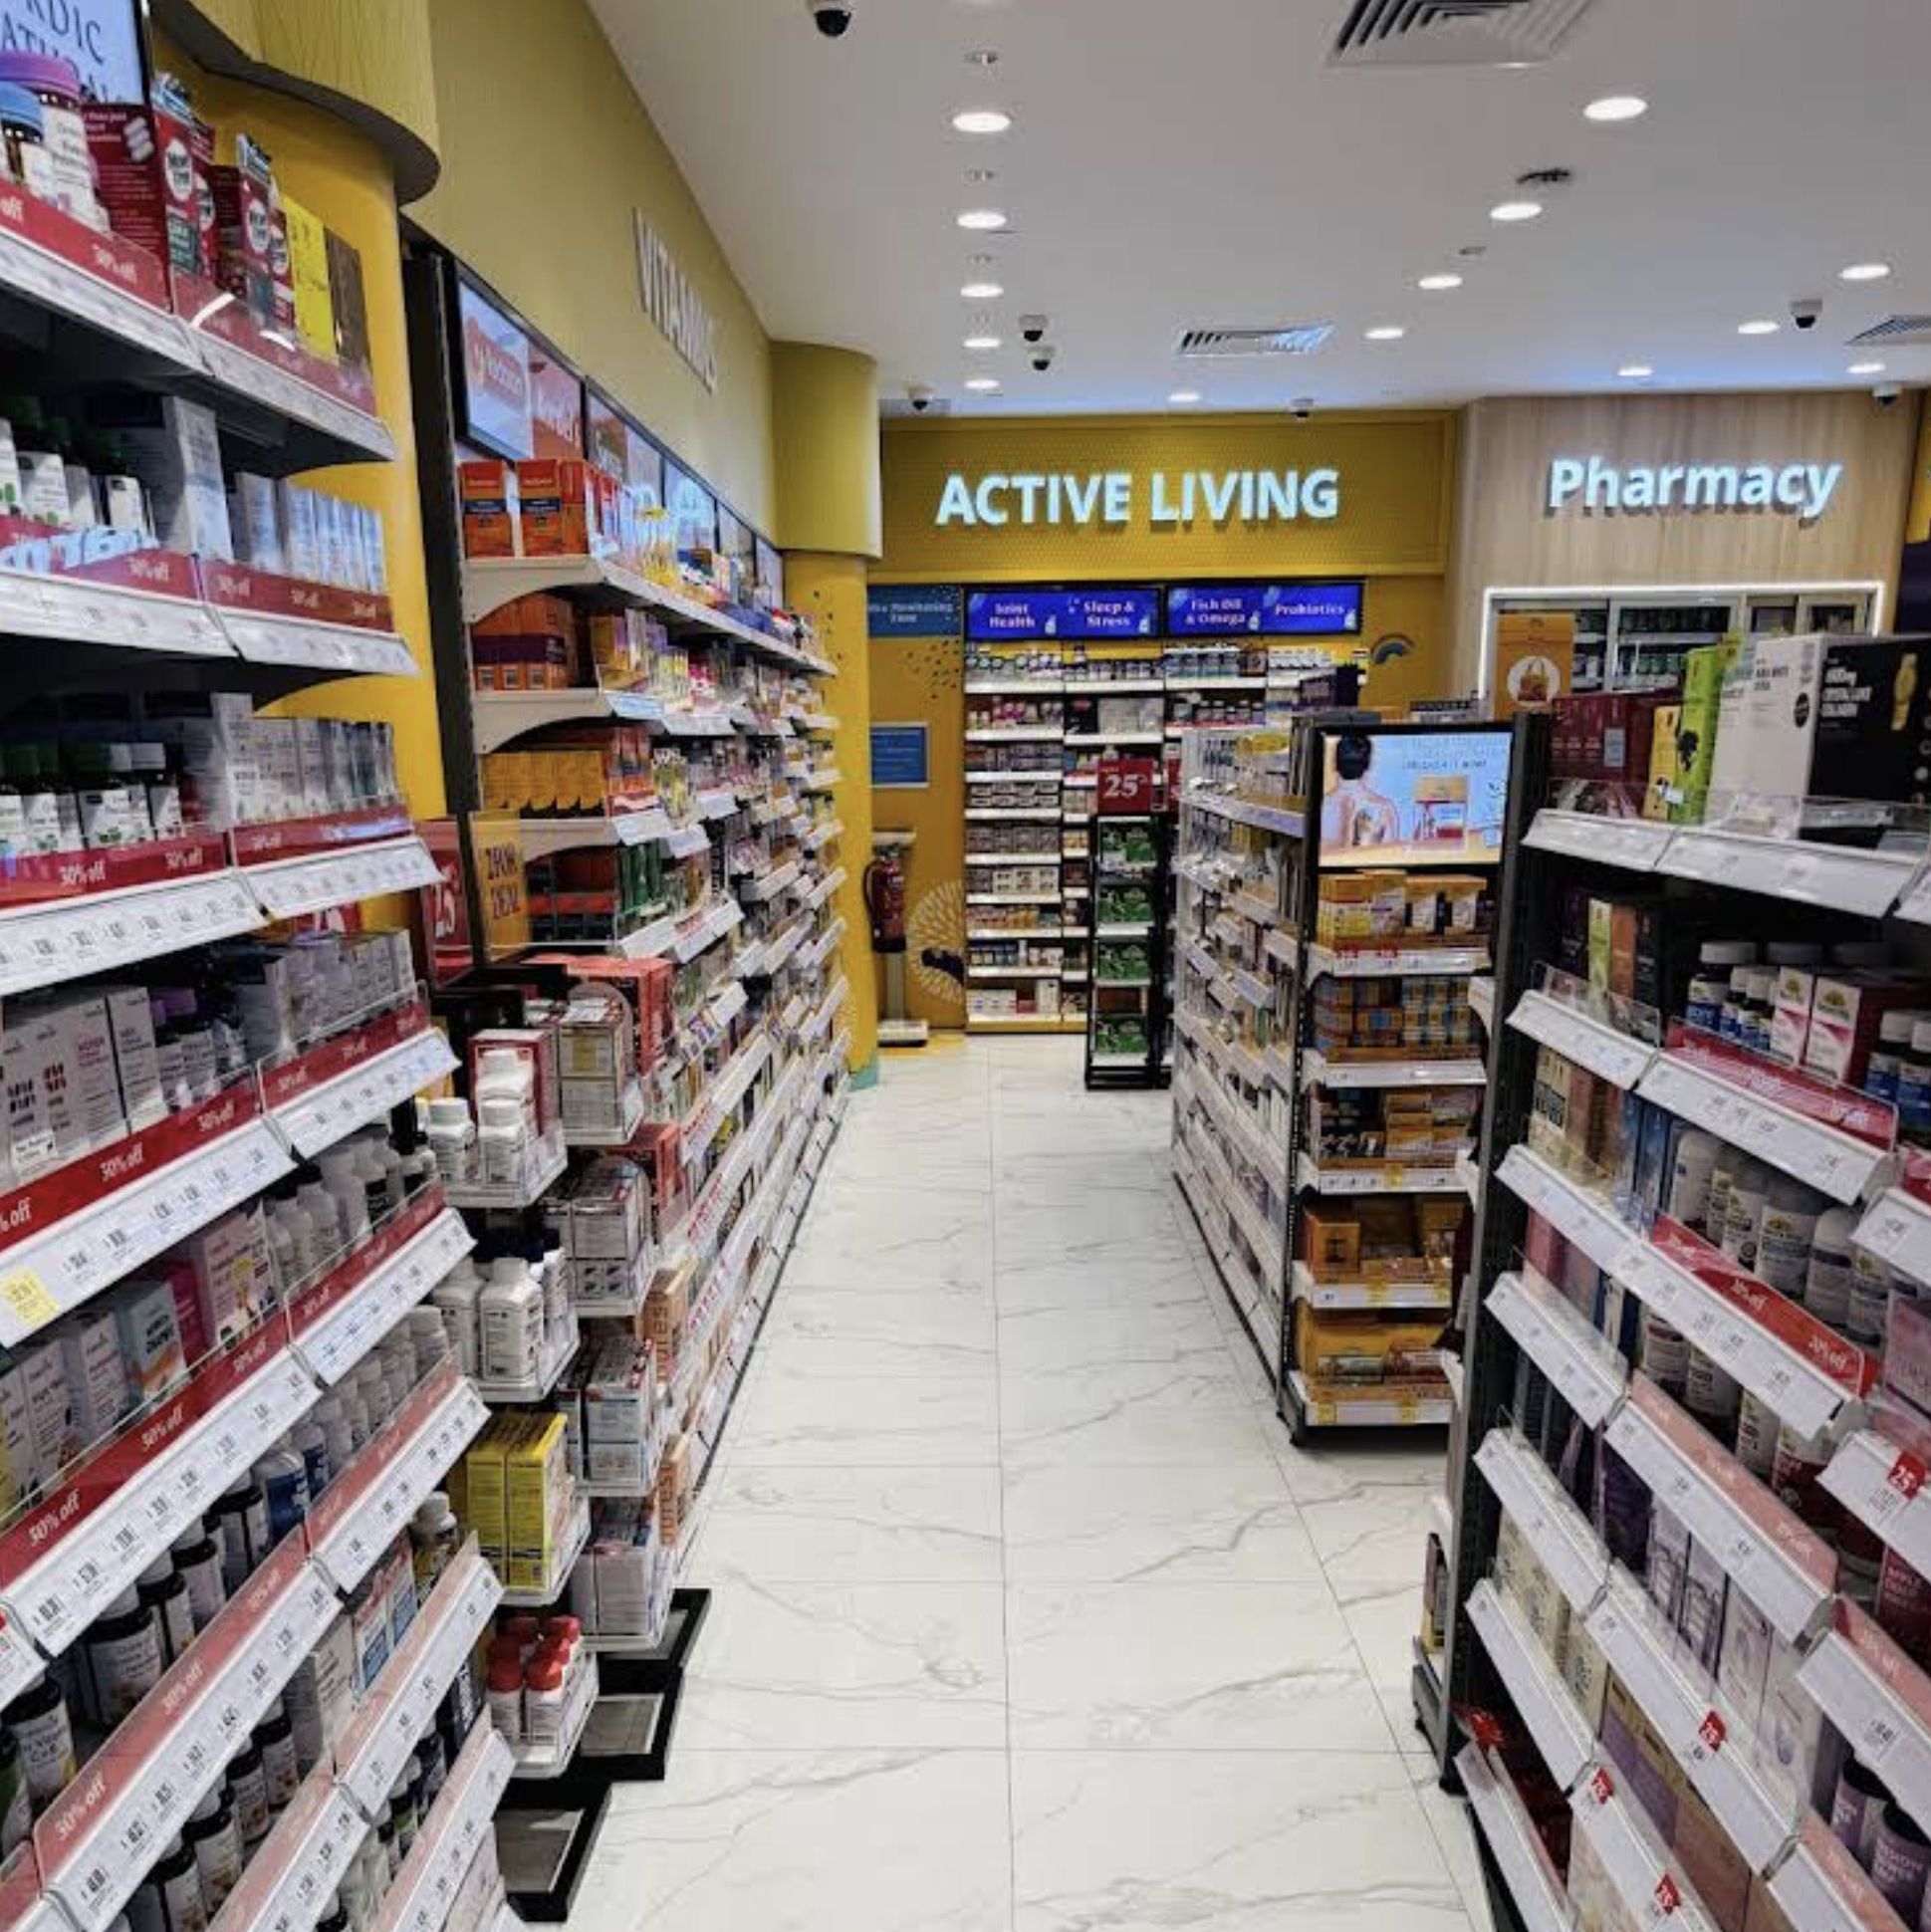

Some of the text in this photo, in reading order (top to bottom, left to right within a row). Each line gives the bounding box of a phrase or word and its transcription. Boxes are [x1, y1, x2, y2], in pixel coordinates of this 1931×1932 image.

[935, 469, 1340, 525] ACTIVE LIVING
[1548, 456, 1842, 519] Pharmacy
[994, 603, 1029, 615] Joint
[1084, 601, 1135, 615] Sleep &
[1191, 599, 1219, 610] Fish
[1275, 604, 1345, 616] Probiotics
[989, 615, 1037, 628] Health
[1086, 615, 1131, 627] Stress
[1198, 613, 1245, 627] Omega
[126, 1142, 143, 1167] off
[10, 1196, 33, 1228] off
[165, 1406, 184, 1434] off
[60, 1488, 81, 1521] off
[86, 1771, 107, 1806] off
